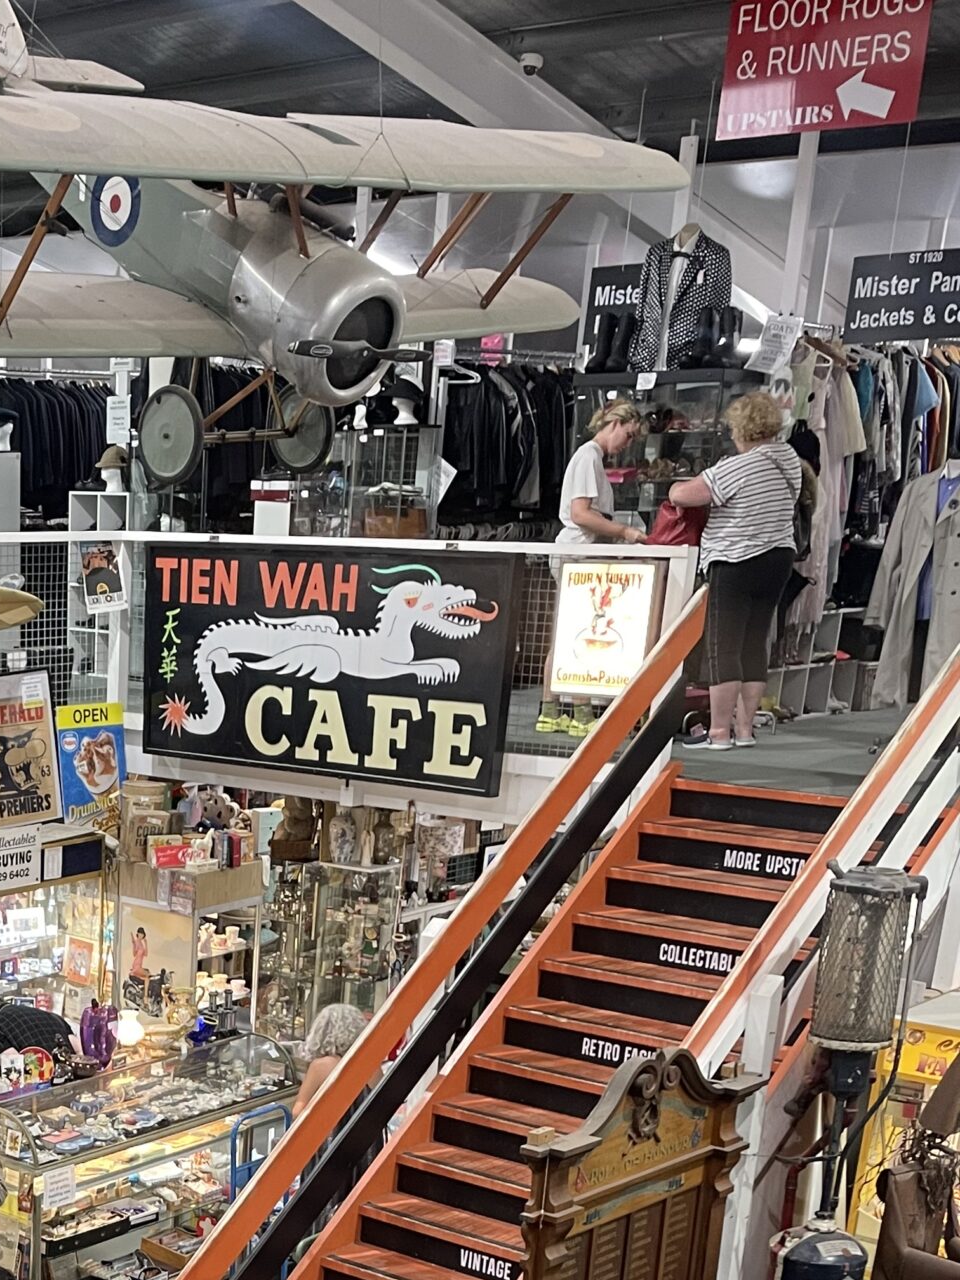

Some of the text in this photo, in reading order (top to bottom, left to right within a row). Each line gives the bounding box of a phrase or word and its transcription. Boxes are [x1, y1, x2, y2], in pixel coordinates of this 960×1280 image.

[737, 0, 830, 35] FLOOR
[737, 30, 911, 80] & RUNNERS
[726, 104, 834, 132] UPSTAIRS
[923, 251, 944, 264] 1920
[854, 274, 920, 299] Mister
[849, 303, 960, 329] Jackets & C
[155, 556, 359, 613] TIEN WAH
[158, 607, 181, 683] 天華
[73, 707, 109, 724] OPEN
[244, 684, 487, 780] CAFE
[0, 793, 51, 818] PREMIERS
[723, 849, 762, 872] MORE
[8, 867, 30, 880] 6402
[581, 1037, 621, 1062] RETRO
